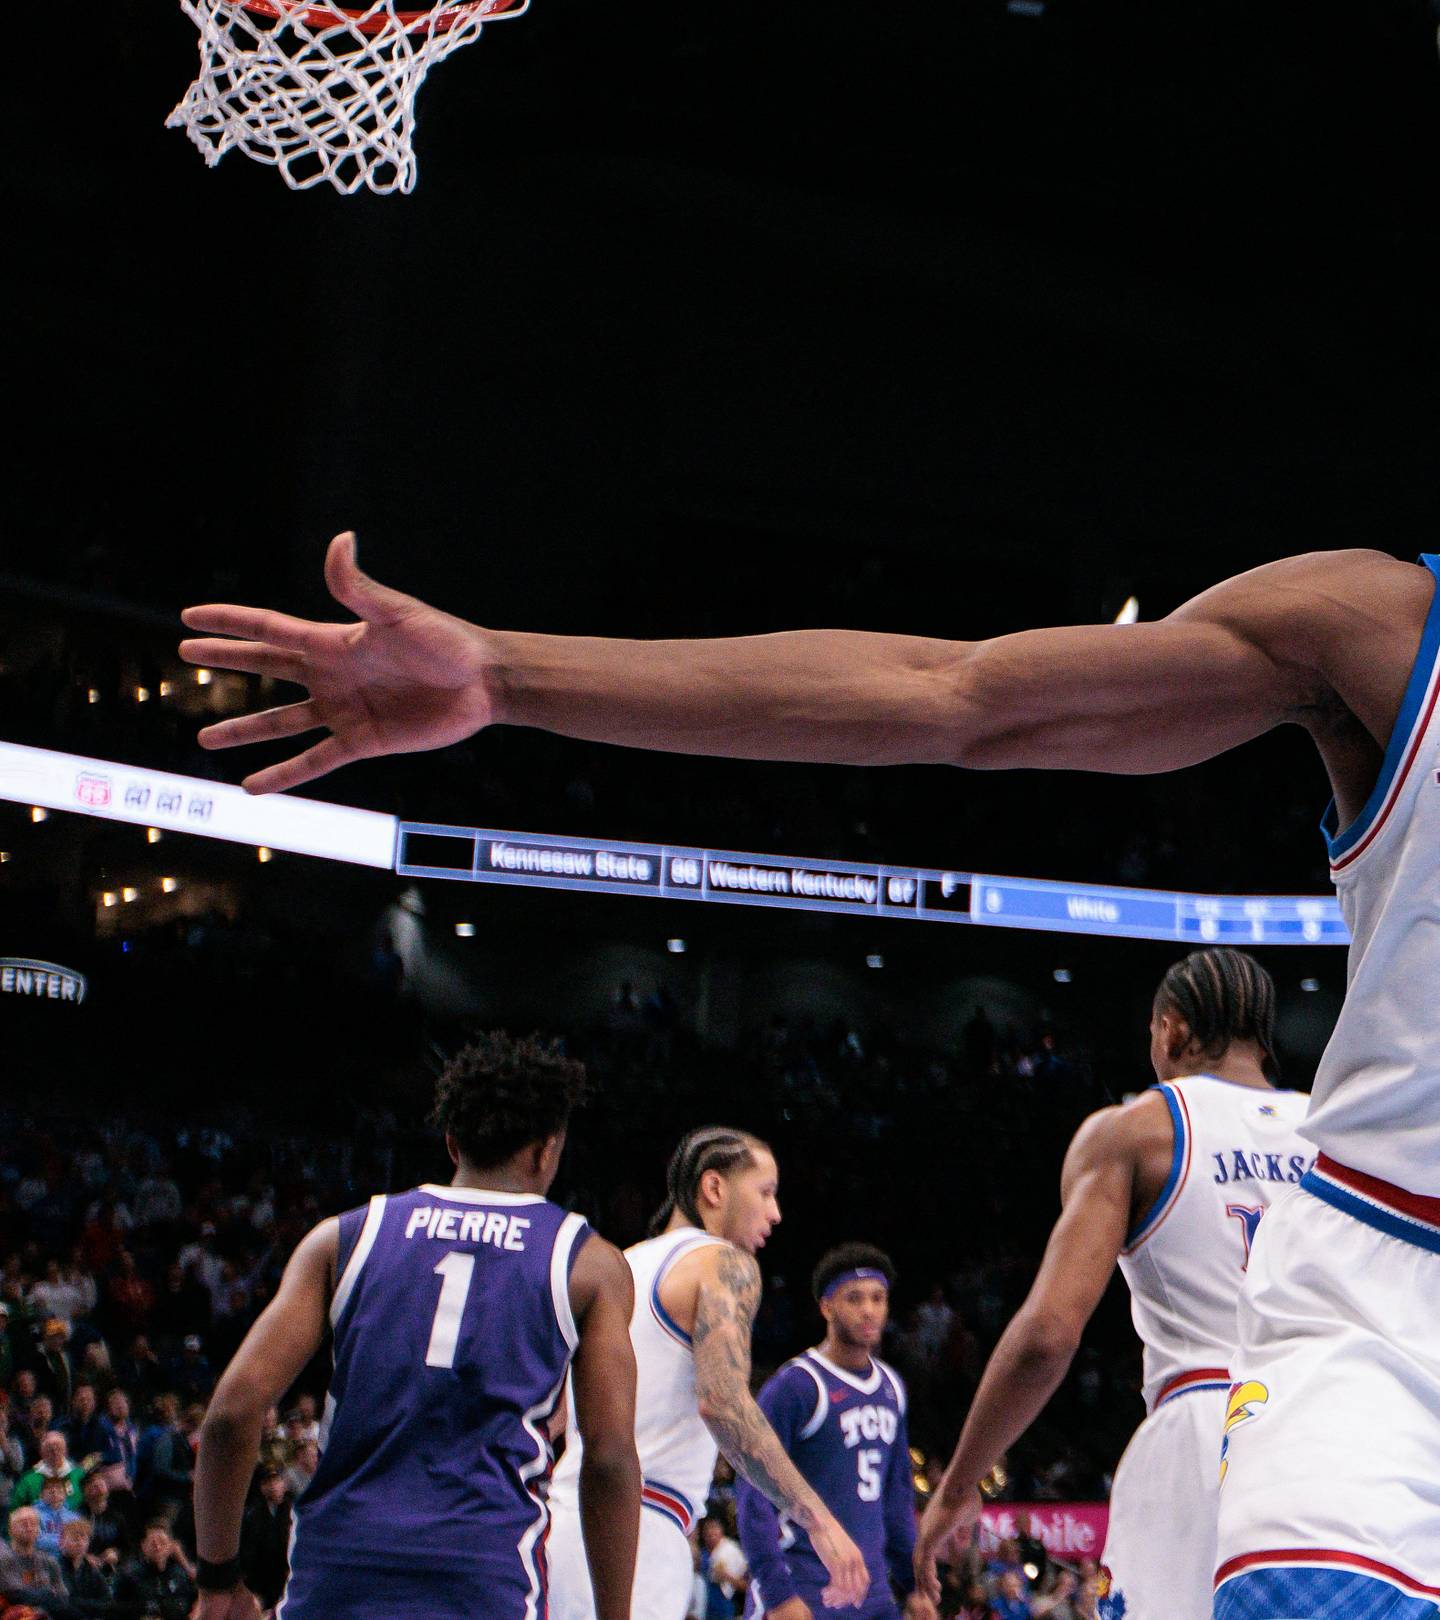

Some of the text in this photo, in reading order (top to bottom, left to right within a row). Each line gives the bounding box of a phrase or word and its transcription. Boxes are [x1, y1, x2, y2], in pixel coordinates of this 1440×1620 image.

[490, 842, 593, 876] Kennesaw
[595, 851, 652, 881] State
[709, 862, 791, 893] Western
[792, 868, 876, 904] Kentucky
[0, 967, 76, 1001] ENTER
[1212, 1149, 1316, 1184] JACKS
[405, 1206, 531, 1251] PIERRE
[425, 1251, 476, 1369] 1
[840, 1404, 898, 1449] TCU
[857, 1448, 881, 1502] 5
[979, 1512, 1096, 1552] Mbile
